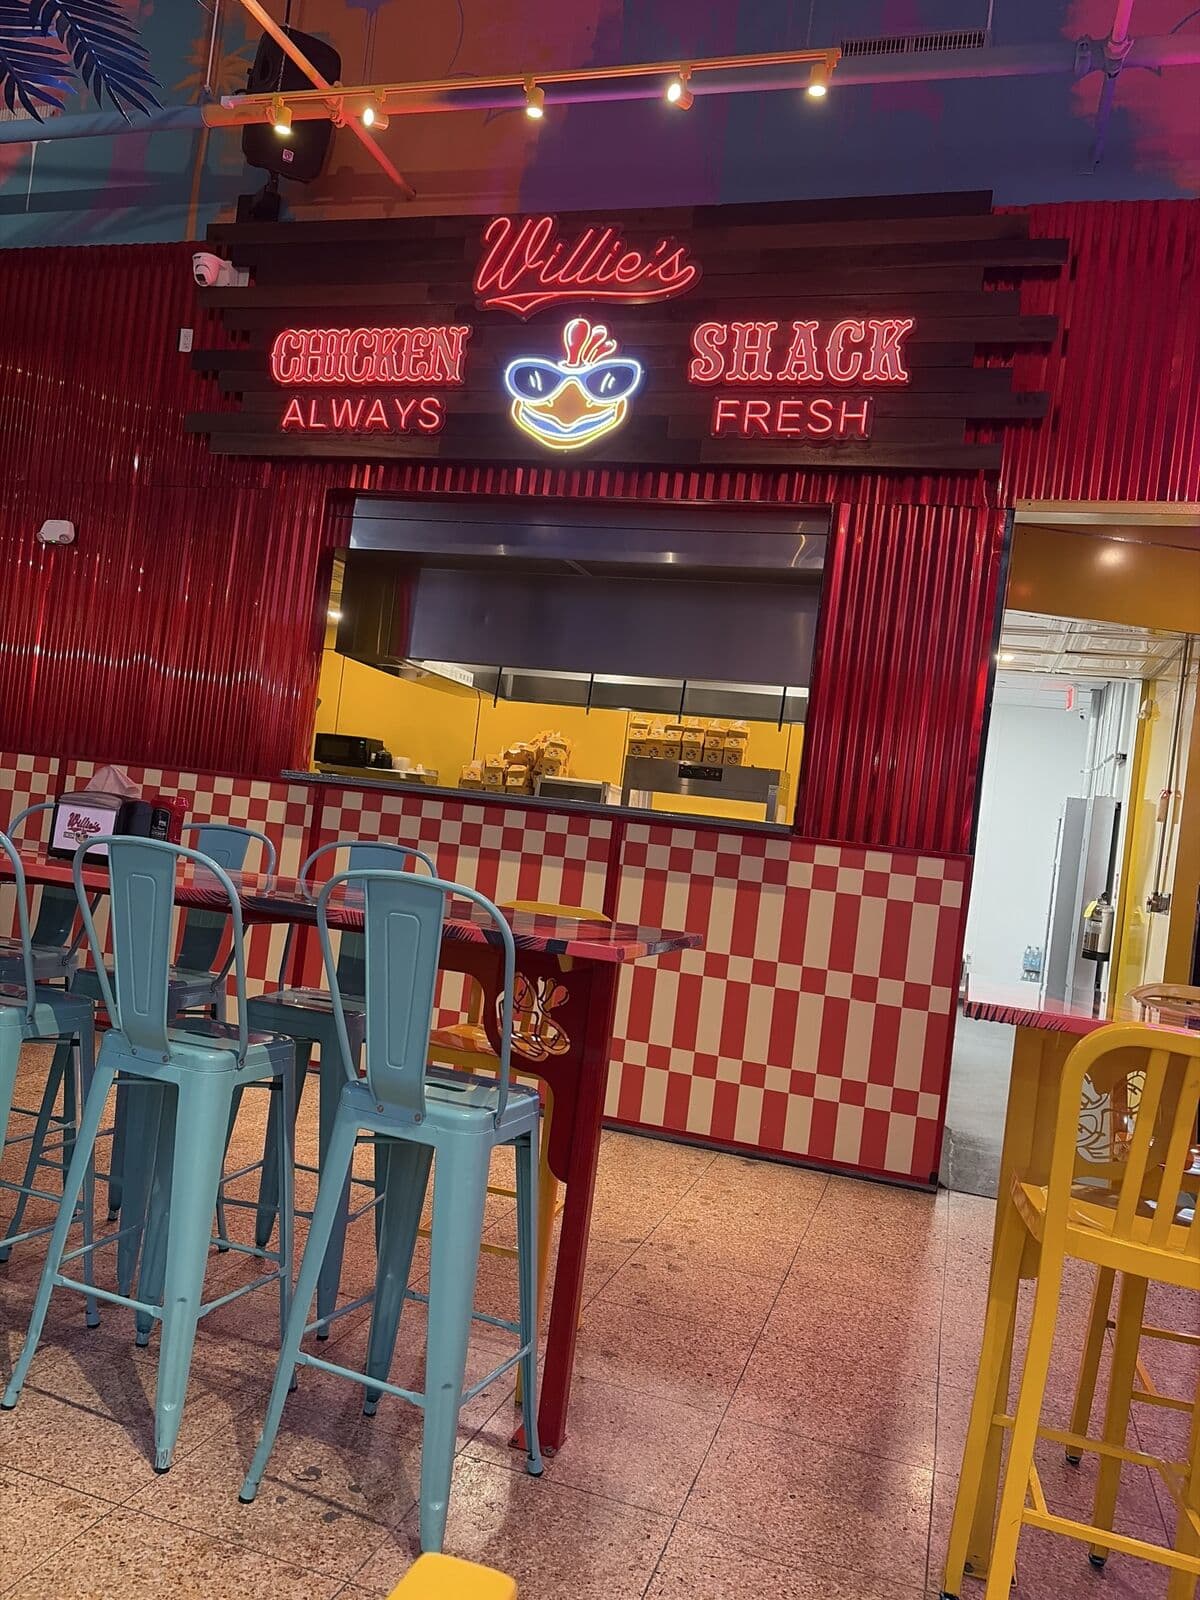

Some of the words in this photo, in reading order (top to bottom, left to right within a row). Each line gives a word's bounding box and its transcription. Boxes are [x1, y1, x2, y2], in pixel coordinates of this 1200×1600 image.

[476, 216, 697, 310] Willie's
[271, 325, 471, 384] CHICKEN
[690, 318, 914, 383] SHACK
[281, 397, 442, 431] ALWAYS
[714, 399, 870, 435] FRESH
[67, 812, 101, 833] Willie's
